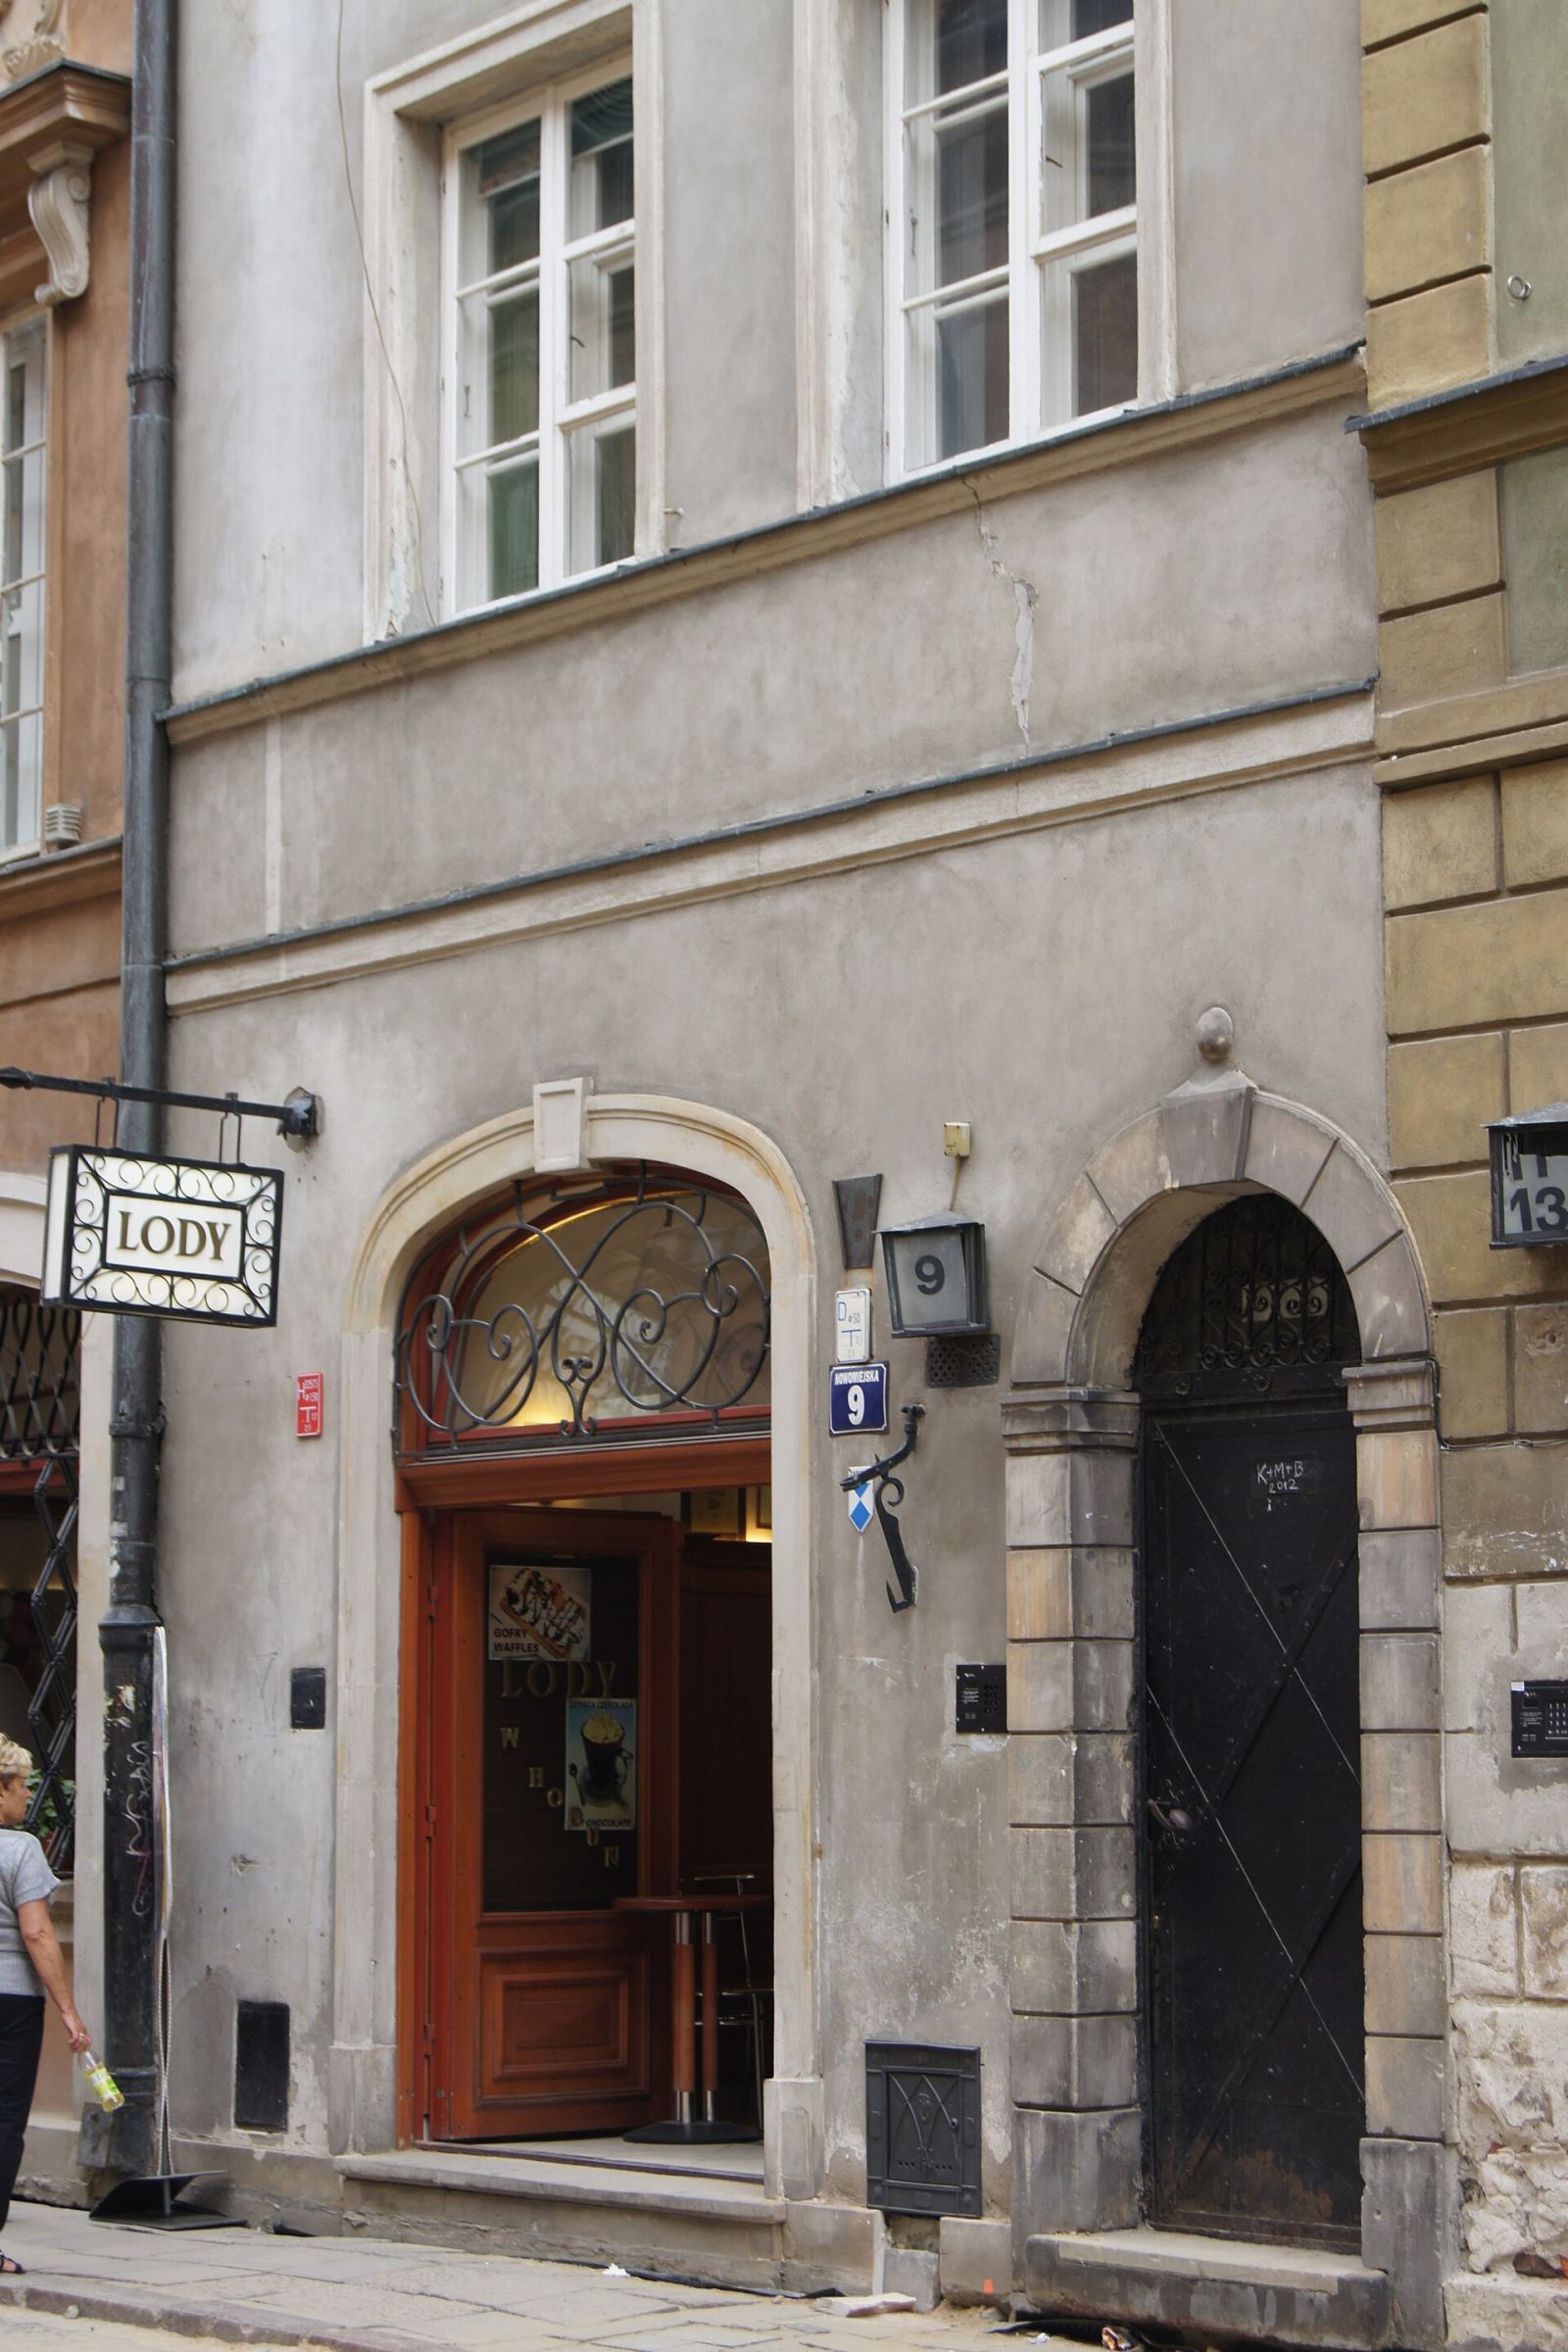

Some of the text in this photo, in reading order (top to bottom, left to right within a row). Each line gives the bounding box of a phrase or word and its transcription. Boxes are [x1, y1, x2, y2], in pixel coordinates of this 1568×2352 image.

[1510, 1186, 1568, 1232] 13
[117, 1210, 231, 1260] LODY
[914, 1254, 946, 1296] 9
[834, 1369, 879, 1386] NOWOMIEJSKA
[847, 1384, 865, 1426] 9
[1269, 1478, 1299, 1494] 2012
[493, 1627, 527, 1639] GOFRY
[493, 1642, 540, 1653] WAFFLES
[501, 1658, 618, 1701] LODY
